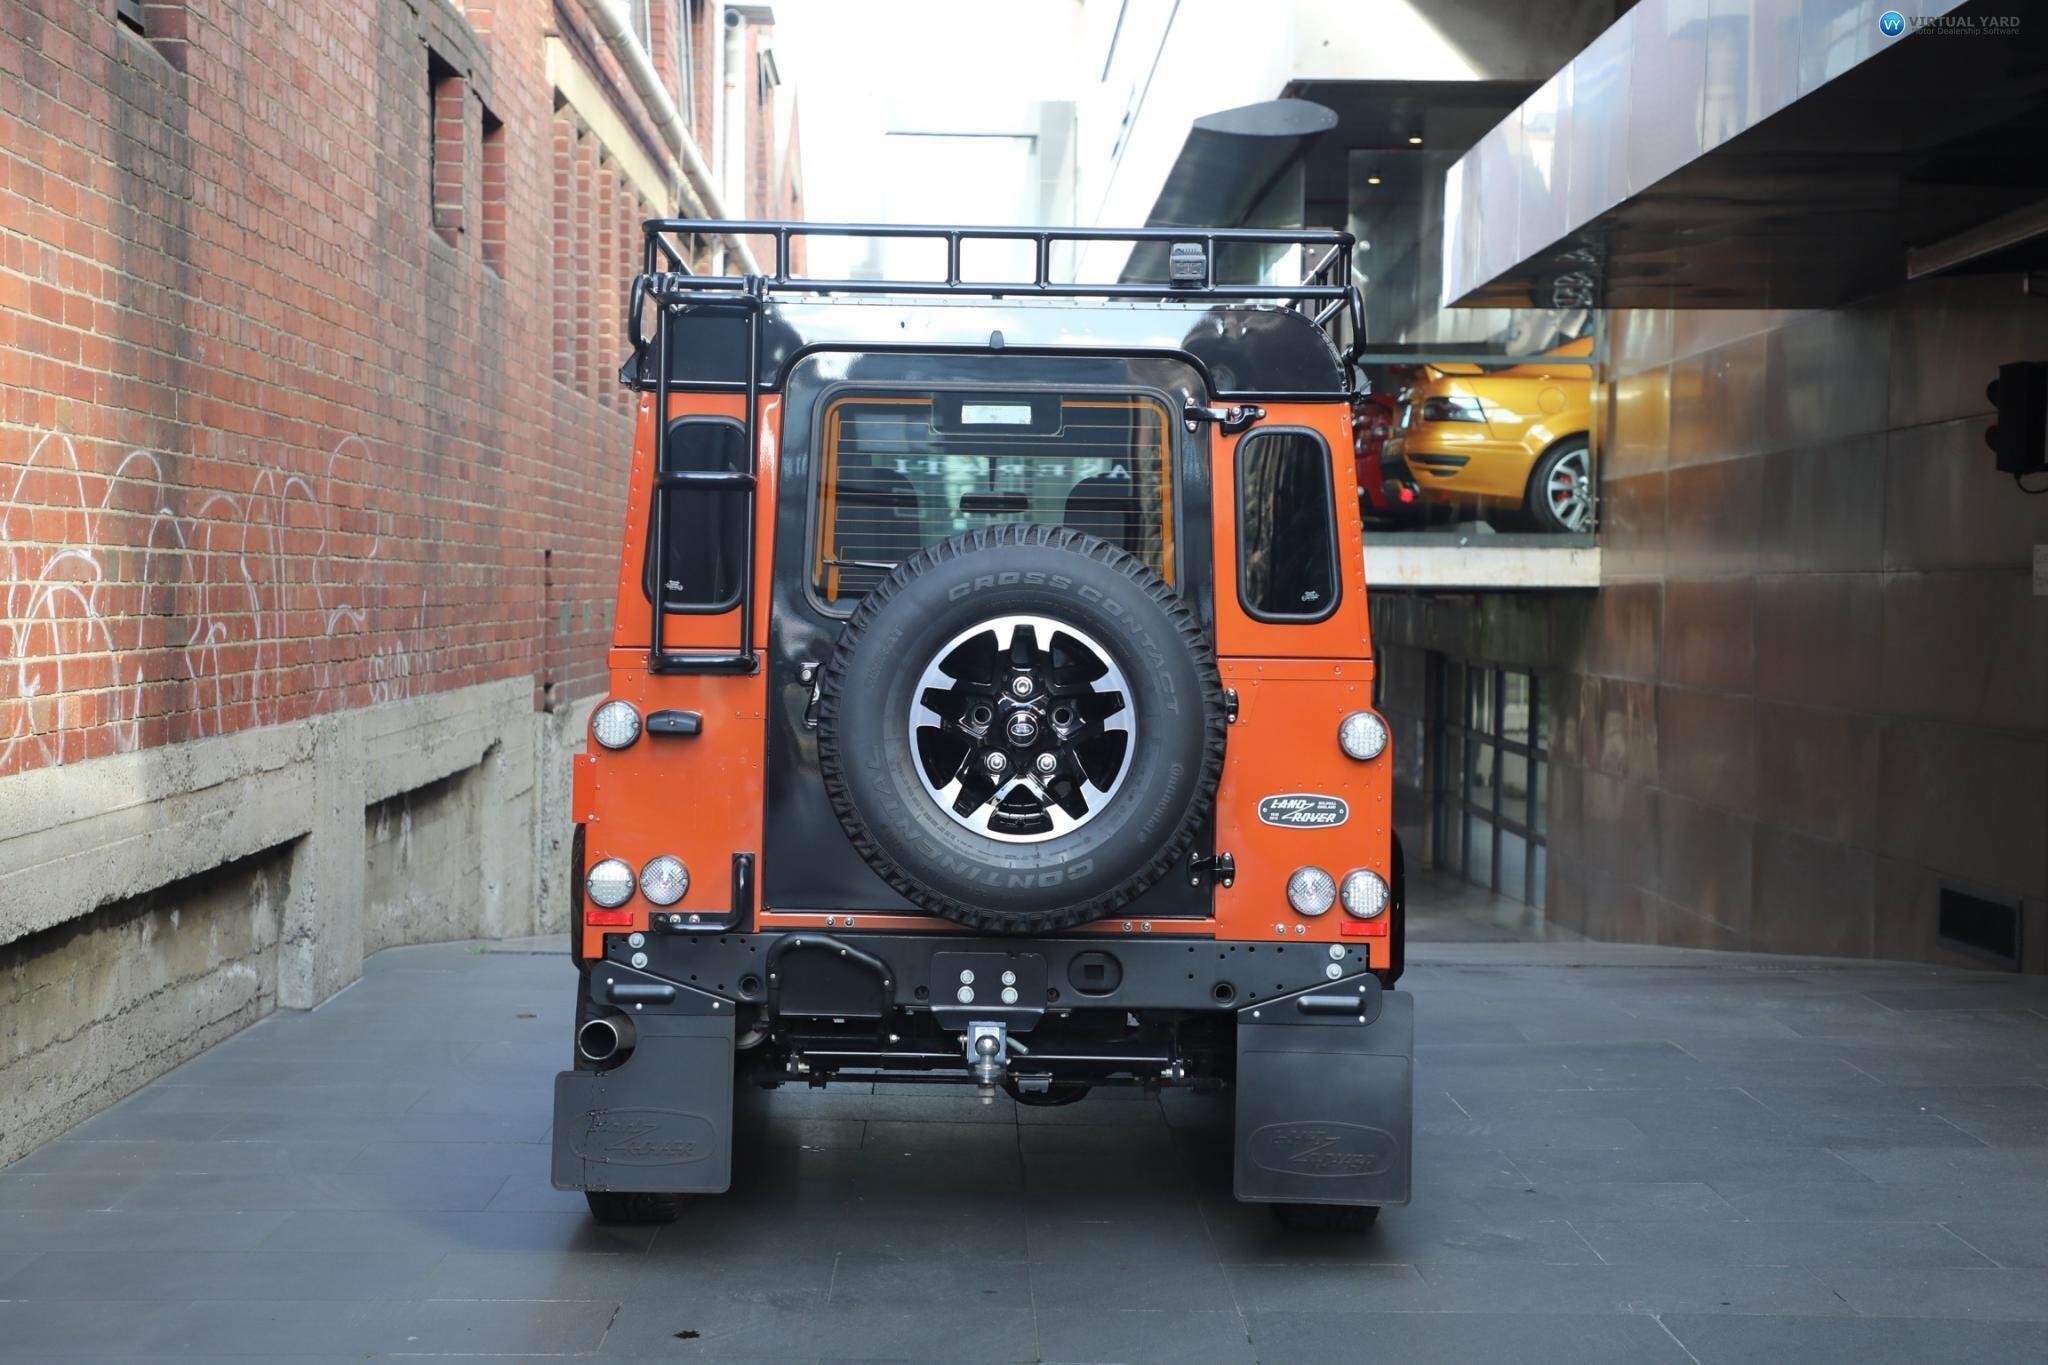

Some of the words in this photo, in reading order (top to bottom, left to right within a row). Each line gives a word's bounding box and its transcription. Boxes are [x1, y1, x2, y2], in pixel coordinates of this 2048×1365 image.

[948, 571, 1073, 602] CROSS
[1077, 587, 1181, 716] CONTACT
[864, 743, 1096, 889] CONTINENTAL
[1270, 799, 1307, 809] LAND
[1291, 812, 1337, 823] ROVER
